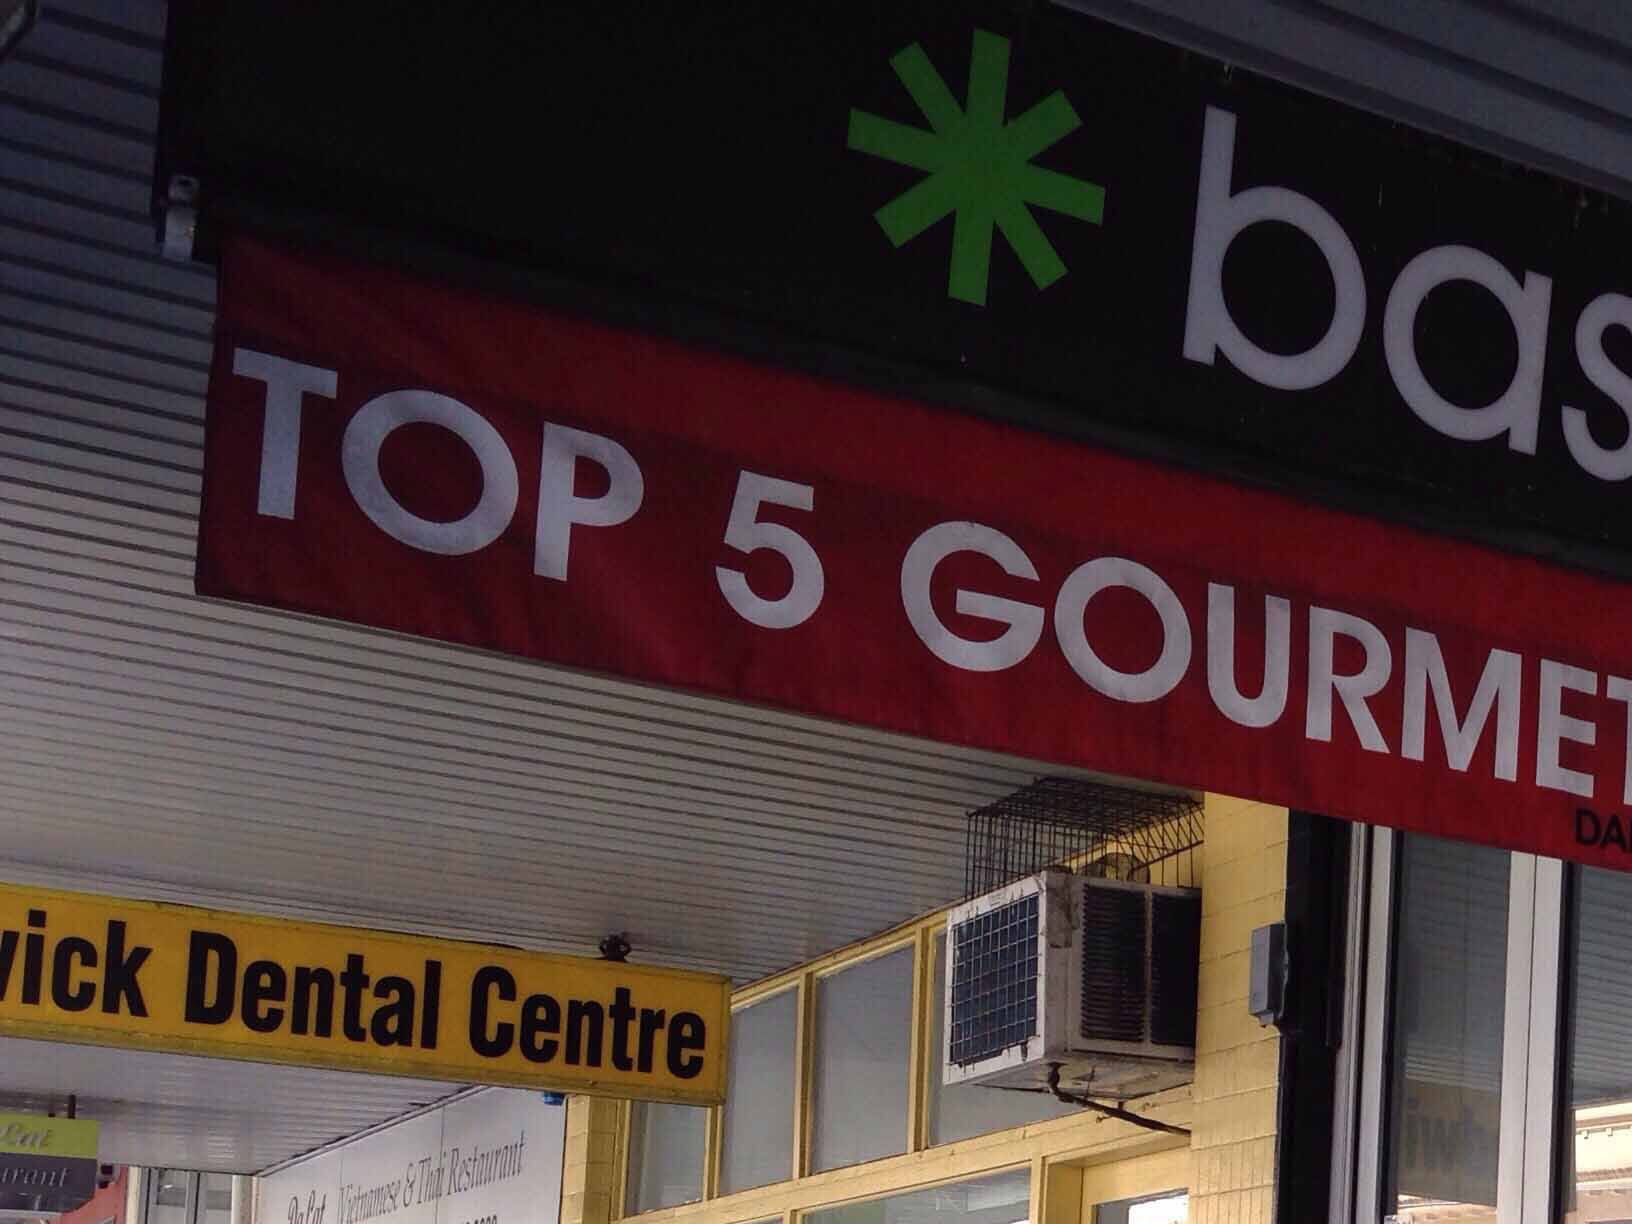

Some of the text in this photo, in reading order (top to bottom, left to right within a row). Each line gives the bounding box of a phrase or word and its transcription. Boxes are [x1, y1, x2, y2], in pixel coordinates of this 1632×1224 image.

[232, 347, 645, 581] TOP
[715, 469, 825, 629] 5
[184, 929, 443, 1051] Dental
[468, 964, 707, 1080] Centre
[402, 1162, 416, 1209] &
[416, 1155, 446, 1205] Thai
[447, 1129, 528, 1196] Restaurant
